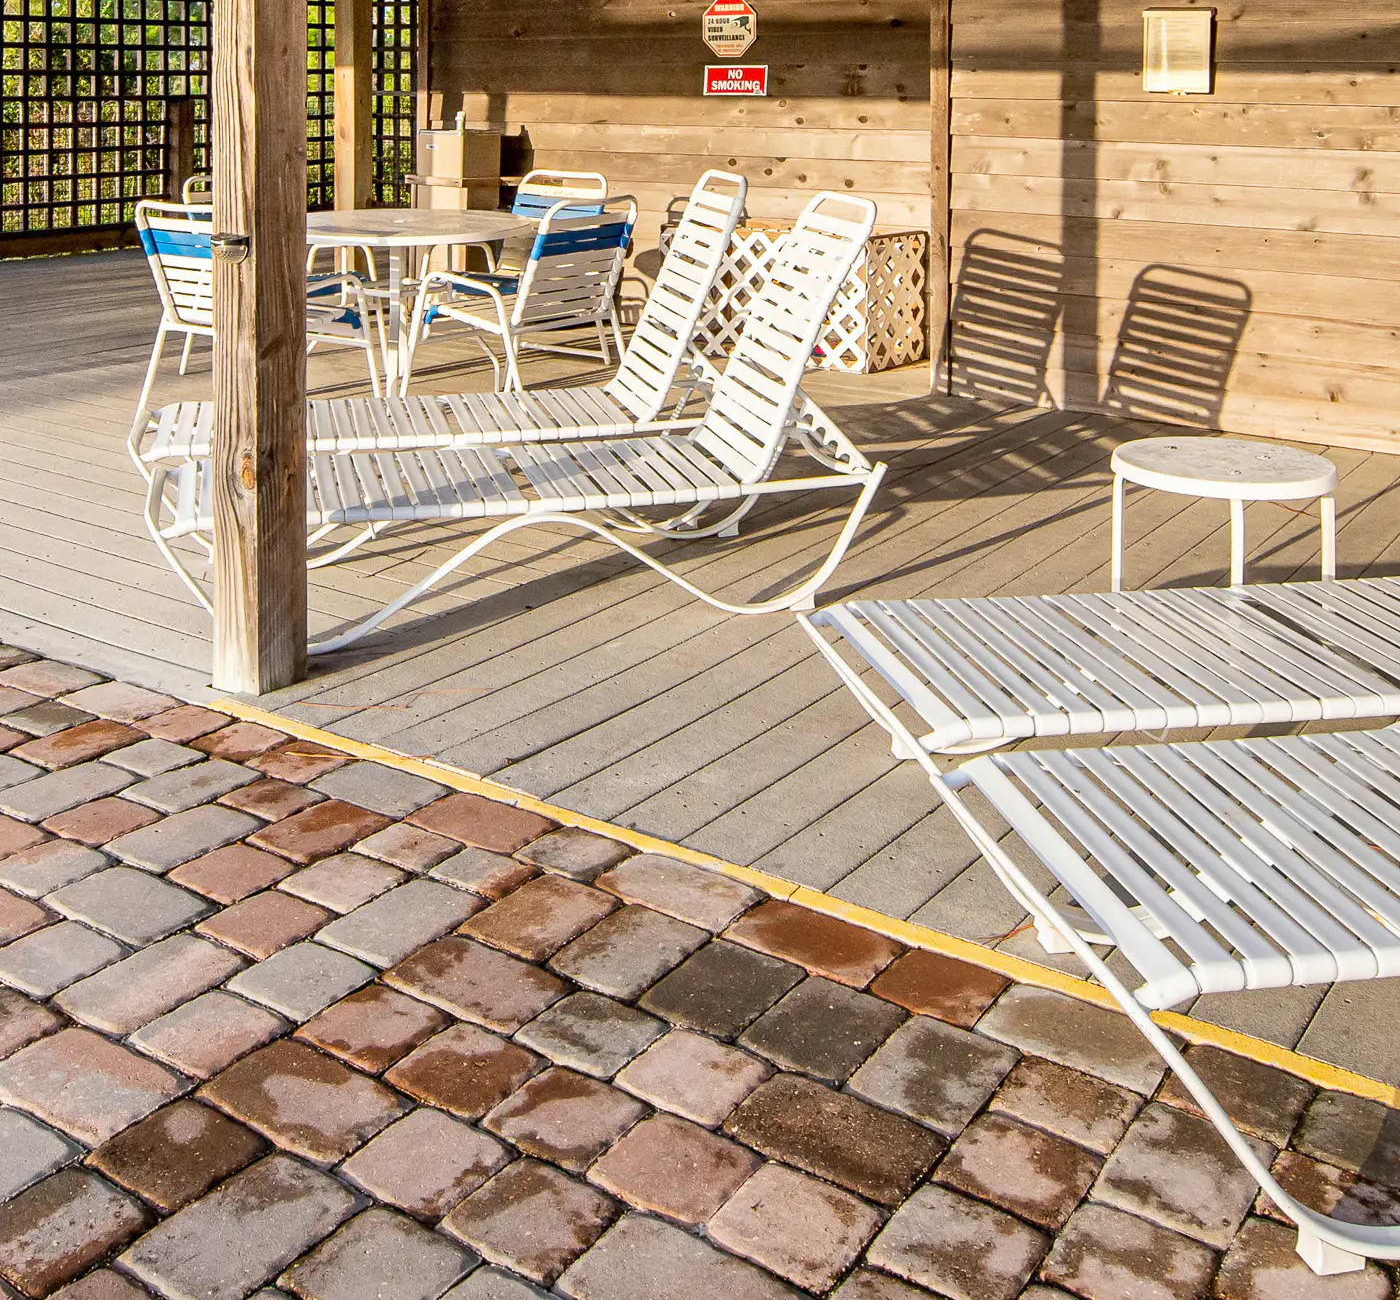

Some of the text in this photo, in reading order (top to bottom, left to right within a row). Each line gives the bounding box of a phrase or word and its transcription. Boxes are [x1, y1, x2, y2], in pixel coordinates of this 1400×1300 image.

[714, 4, 744, 12] WARNING
[715, 17, 730, 25] HOUR
[727, 69, 743, 80] NO
[711, 80, 760, 91] SMOKING
